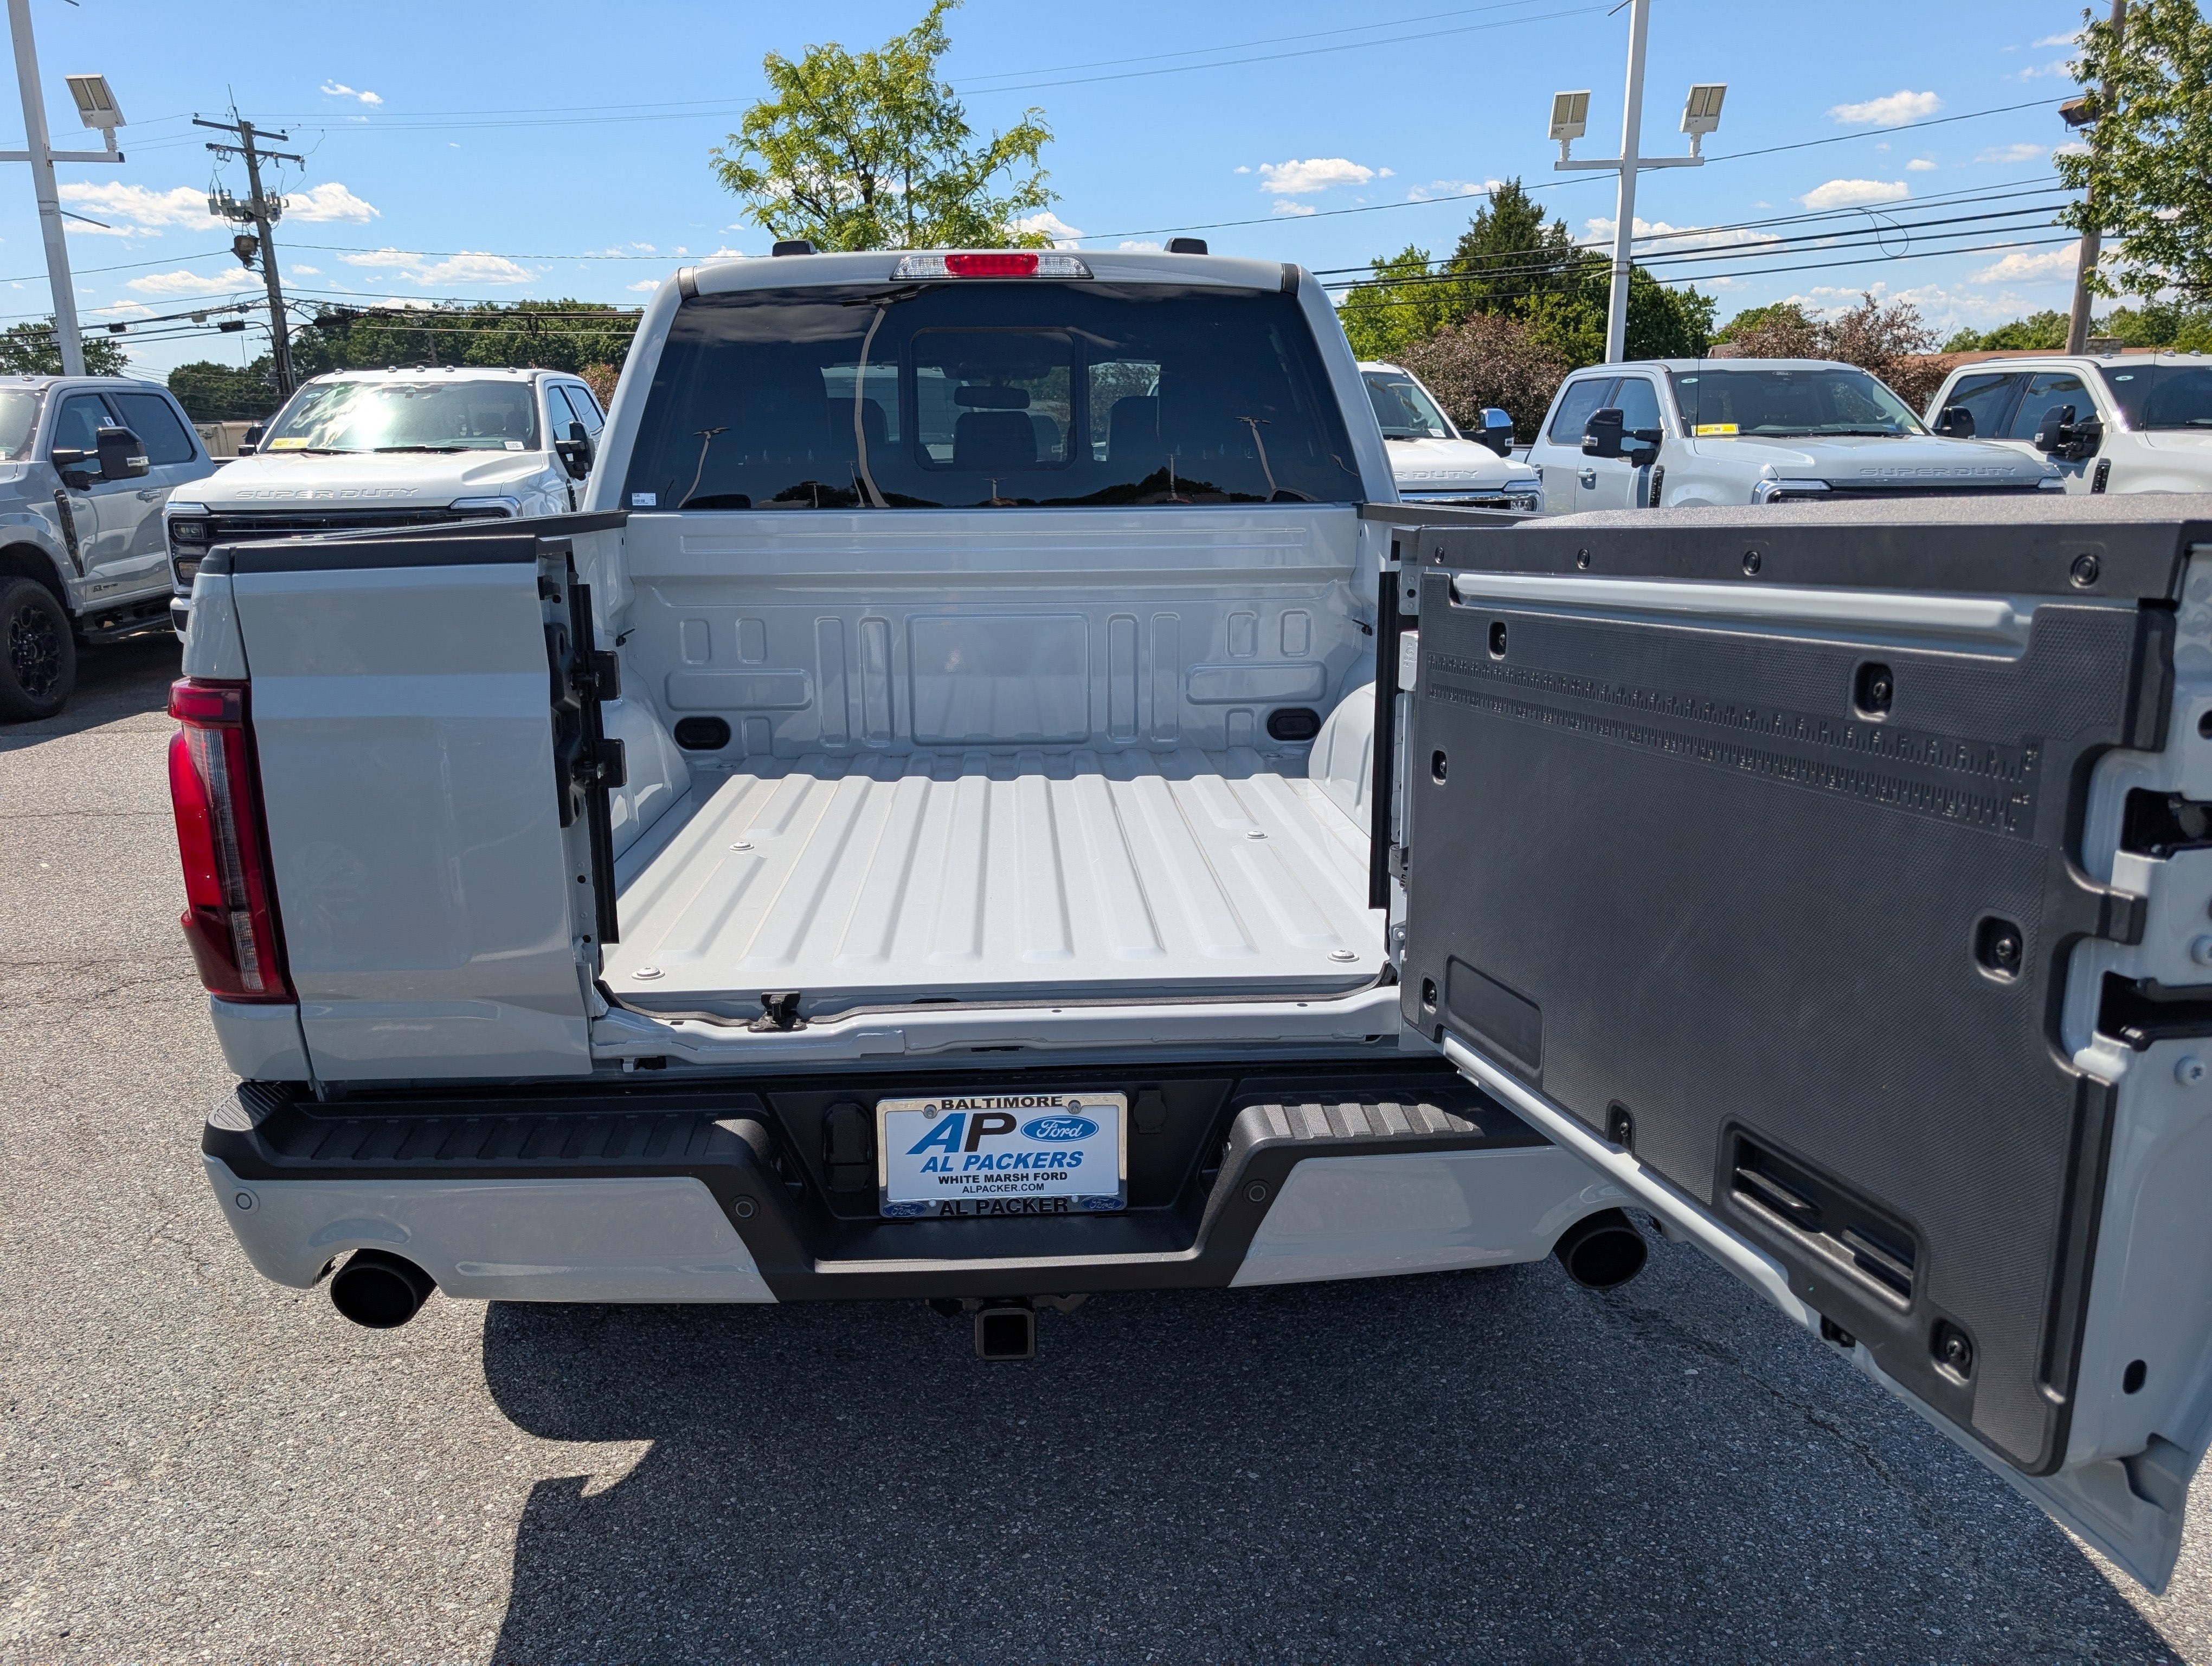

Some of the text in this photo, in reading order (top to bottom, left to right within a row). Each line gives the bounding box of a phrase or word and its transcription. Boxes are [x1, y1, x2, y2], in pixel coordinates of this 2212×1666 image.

[1412, 470, 1479, 479] DUTY
[1860, 466, 2016, 476] SUPER DUTY
[235, 488, 419, 499] SUPER DUTY
[941, 1096, 1063, 1110] BALTIMORE
[905, 1112, 1017, 1155] AP
[1036, 1117, 1084, 1138] Ford
[919, 1151, 1084, 1174] AL PACKERS
[938, 1171, 1068, 1185] WHITE MARSH FORD
[962, 1183, 1044, 1194] ALPACKER.COM
[890, 1203, 918, 1216] Ford
[939, 1196, 1068, 1216] AL PACKER
[1088, 1197, 1116, 1210] Ford
